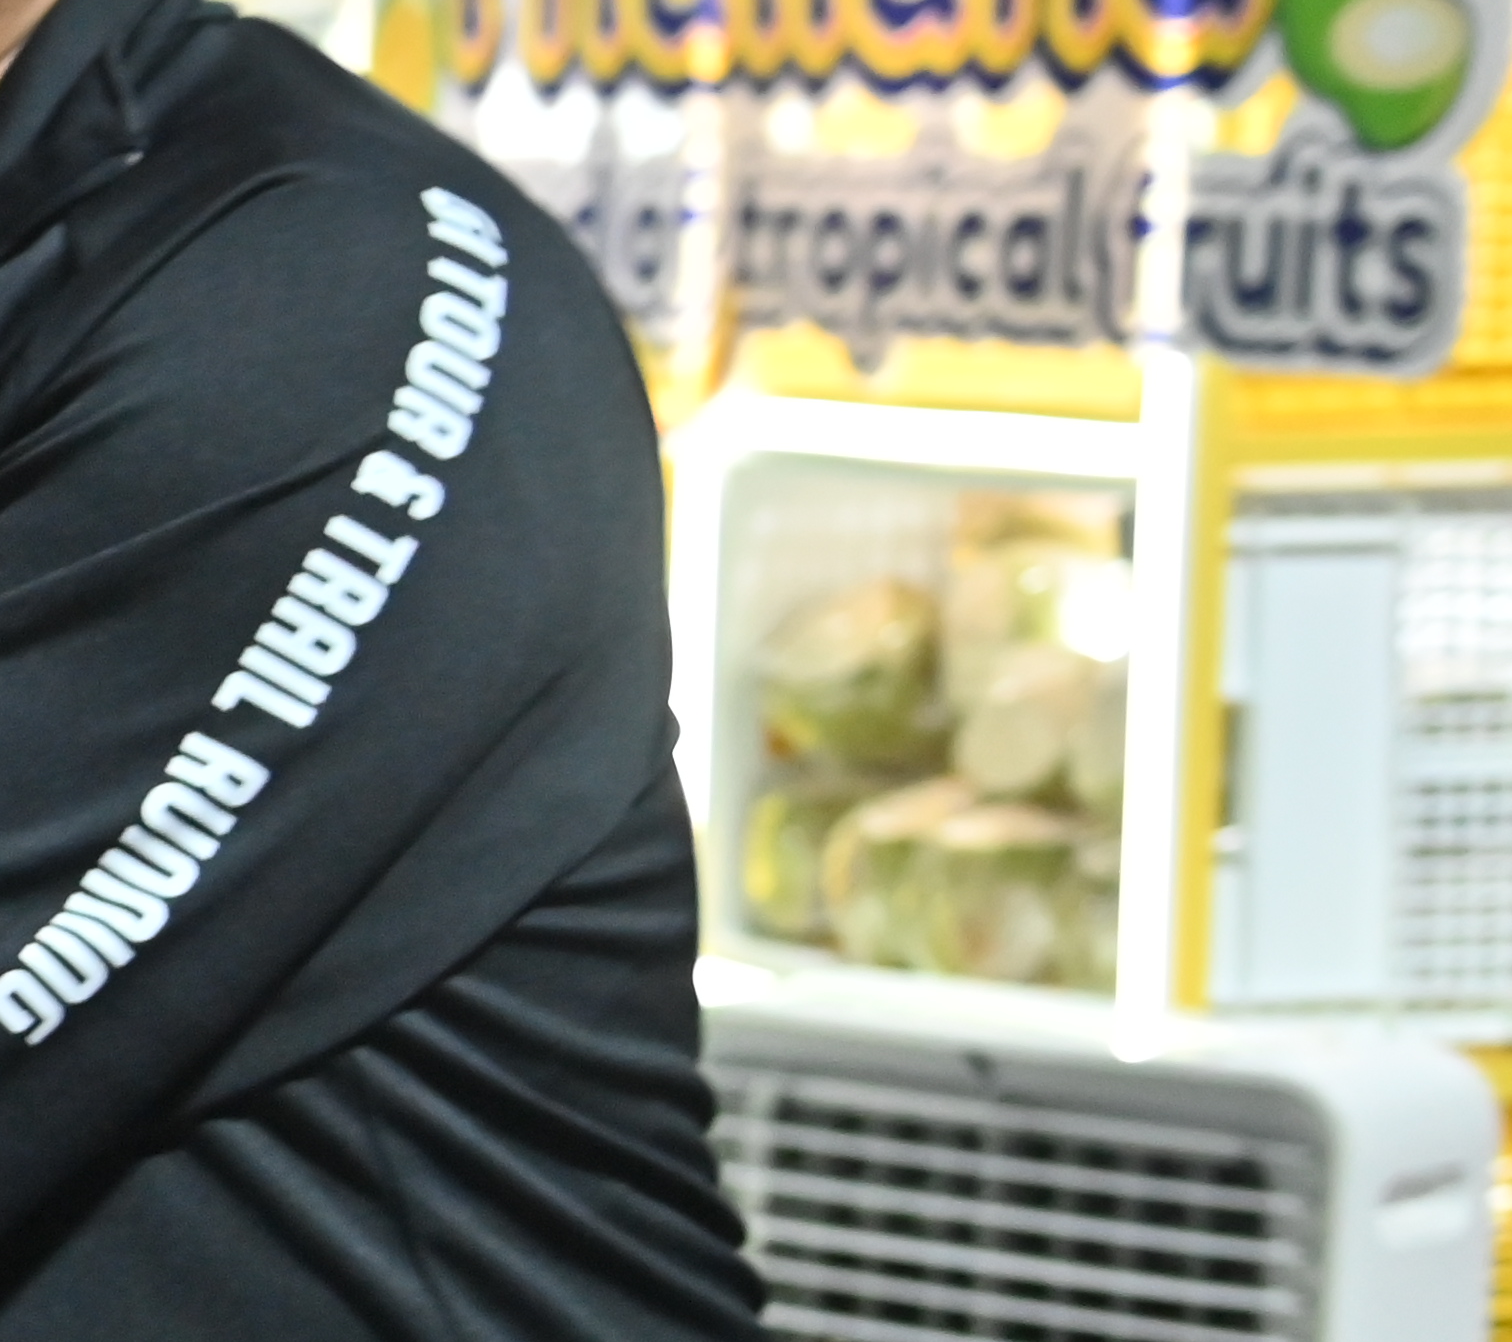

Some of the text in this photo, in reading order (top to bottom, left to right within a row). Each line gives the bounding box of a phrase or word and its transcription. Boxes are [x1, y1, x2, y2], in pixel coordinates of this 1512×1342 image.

[730, 166, 1086, 327] tropical
[386, 255, 509, 461] TOUR
[350, 448, 446, 521] &
[210, 513, 420, 730] TRAIL
